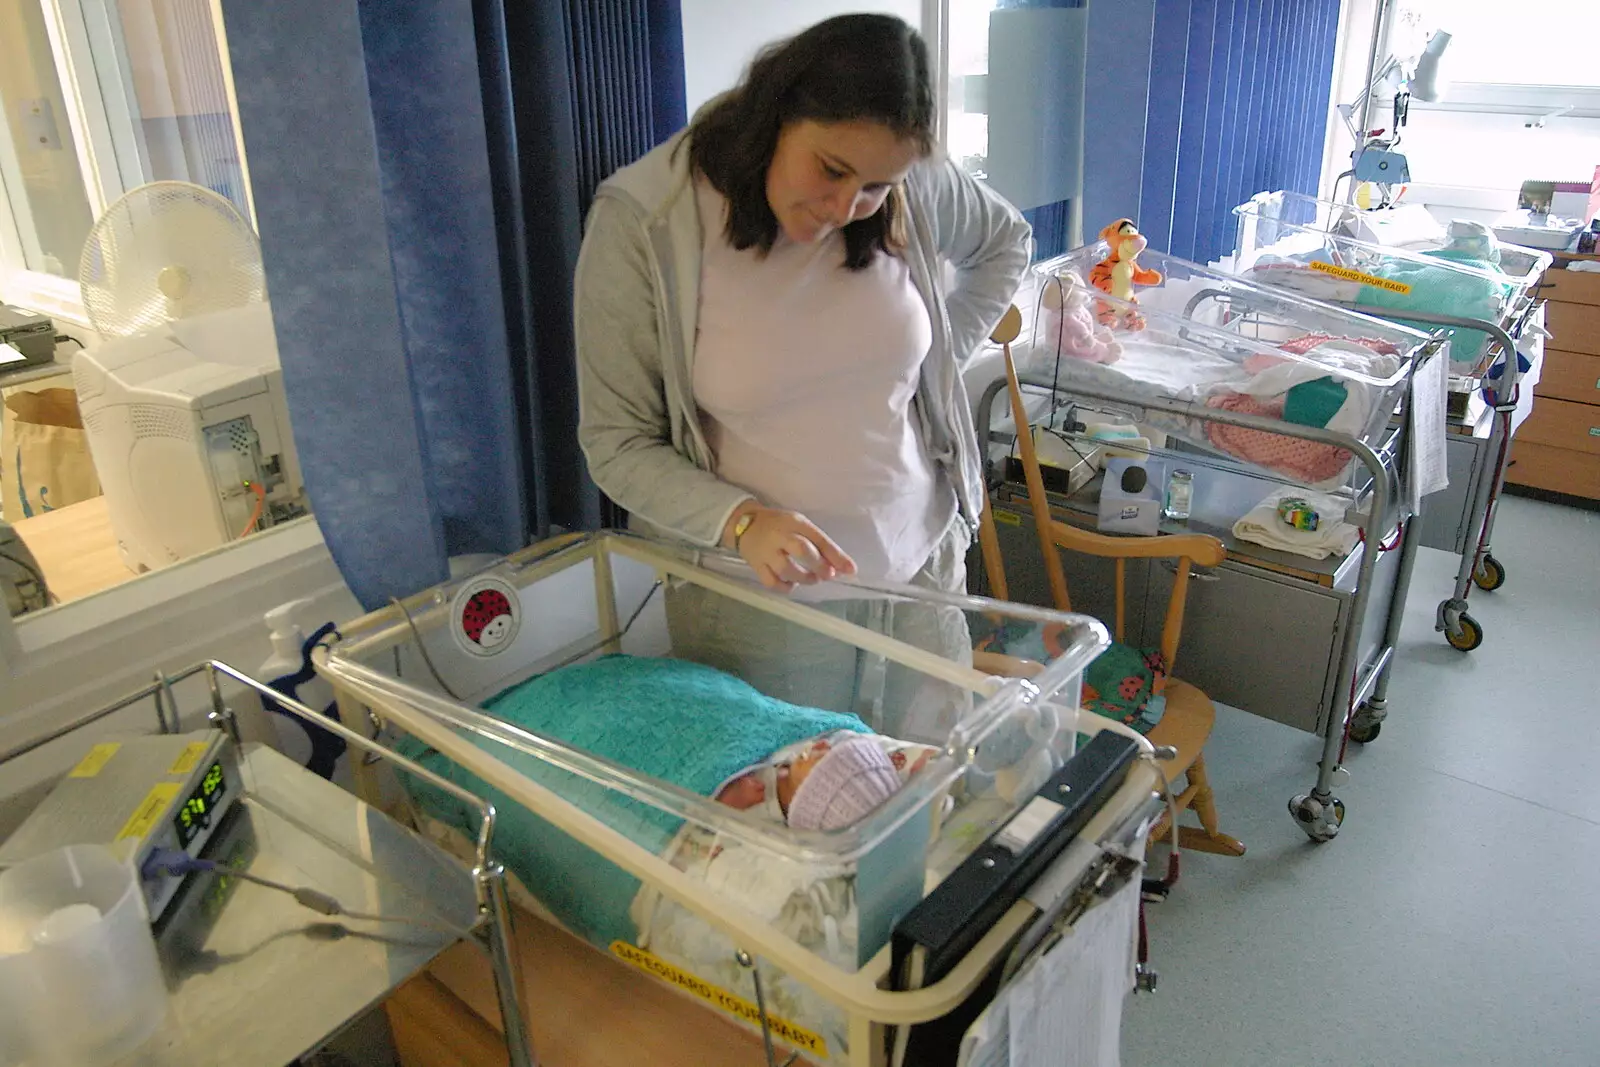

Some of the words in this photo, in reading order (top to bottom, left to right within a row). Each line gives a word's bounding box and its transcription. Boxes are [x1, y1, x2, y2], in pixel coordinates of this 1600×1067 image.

[1312, 262, 1359, 281] SAFEGUARD
[1360, 275, 1384, 287] YOUR
[1384, 281, 1408, 293] BABY
[615, 943, 711, 998] SAFEGUARD
[718, 991, 763, 1021] YOUR
[766, 1016, 816, 1048] BABY
